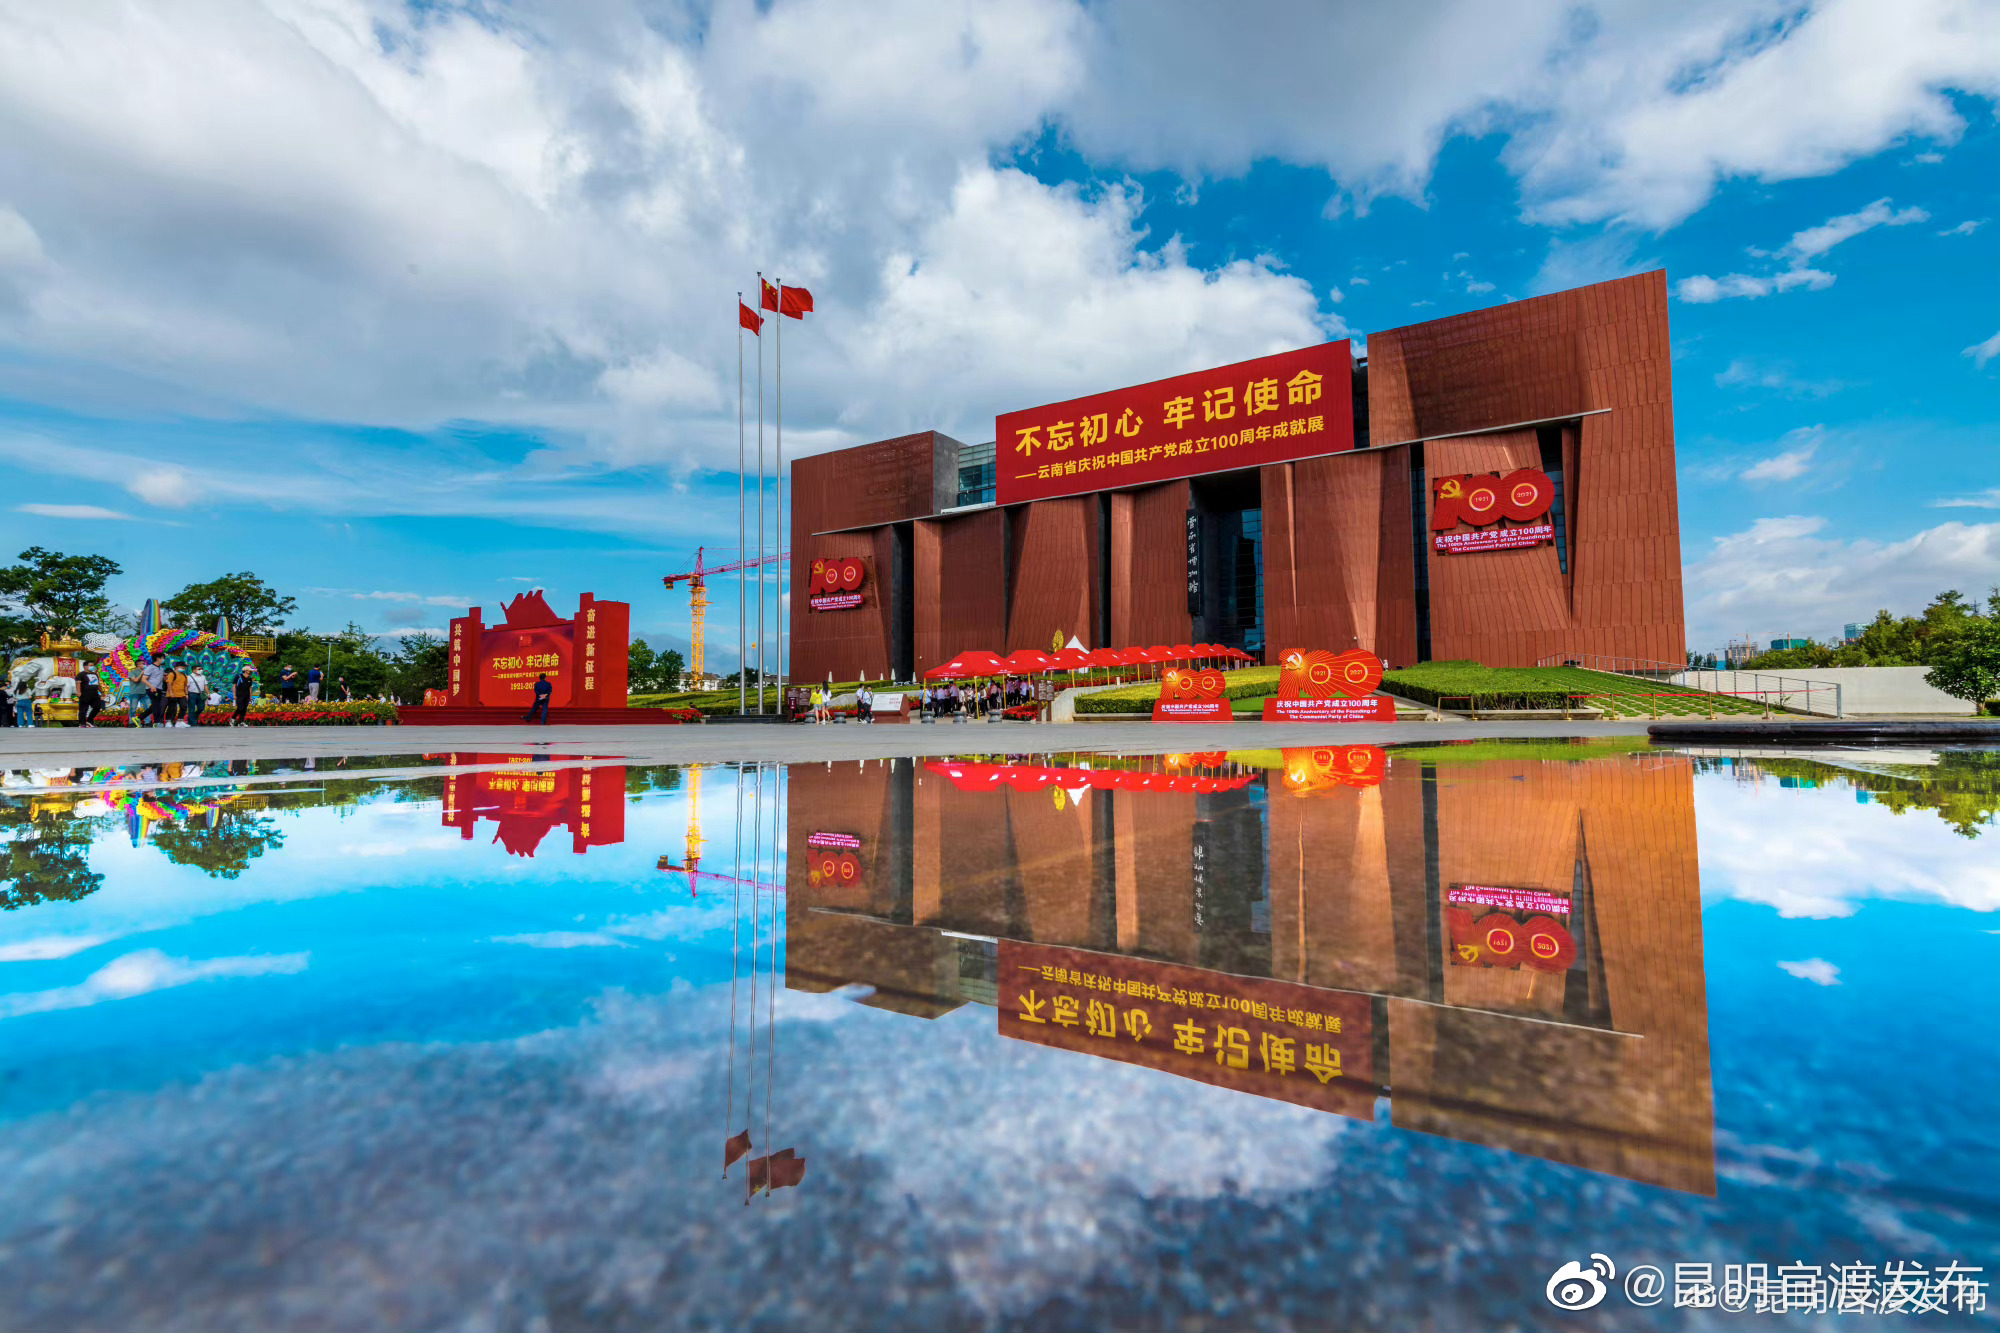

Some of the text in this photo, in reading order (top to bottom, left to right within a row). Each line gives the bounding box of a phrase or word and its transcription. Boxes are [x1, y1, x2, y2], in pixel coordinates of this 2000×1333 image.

[1015, 369, 1324, 457] 不忘初心 牢记使命
[453, 623, 462, 697] 共筑中国梦
[492, 652, 559, 670] 不忘初心 牢记使命
[586, 608, 596, 690] 奋进新征程
[1276, 699, 1378, 708] 庆祝中国共产党成立100周年
